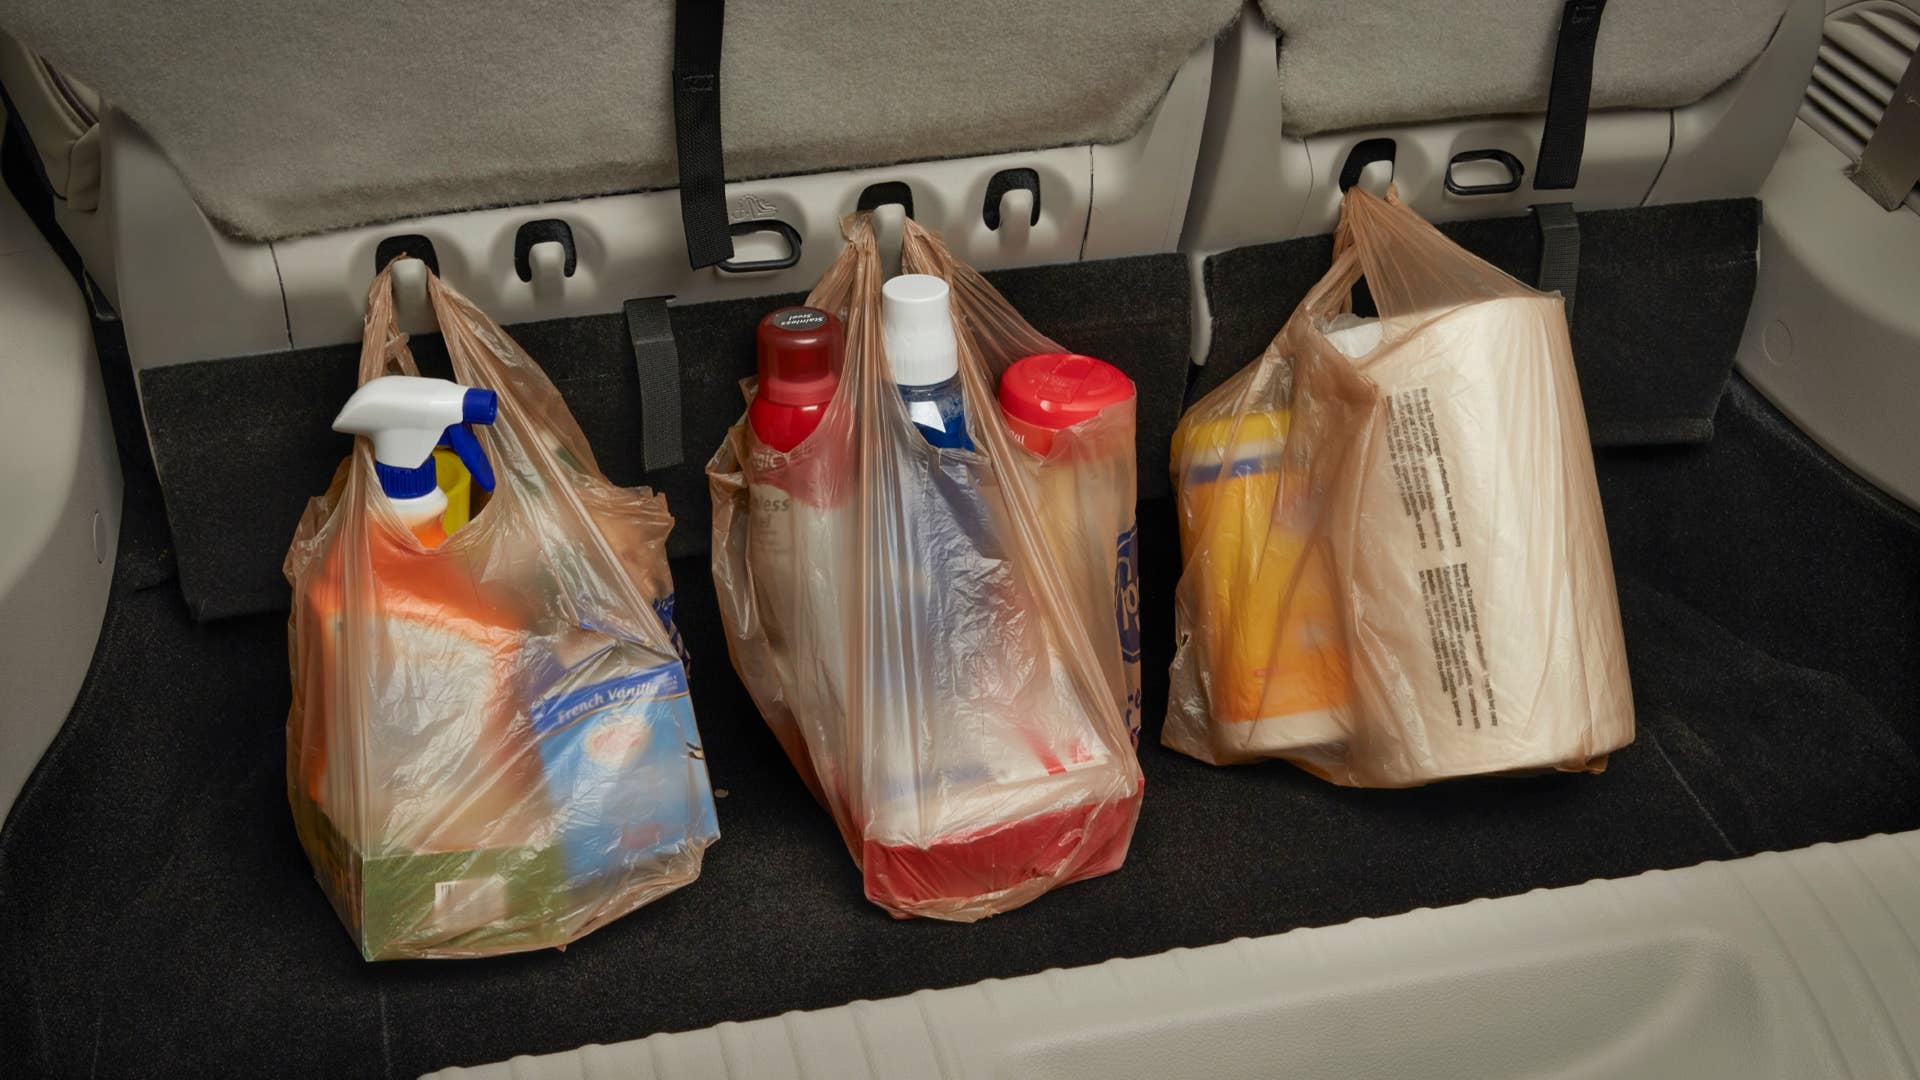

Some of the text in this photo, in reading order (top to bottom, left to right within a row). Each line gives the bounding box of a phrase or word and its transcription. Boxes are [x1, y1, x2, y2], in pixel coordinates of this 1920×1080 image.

[781, 316, 825, 326] Stainless
[788, 313, 812, 321] Steel
[557, 693, 604, 724] French
